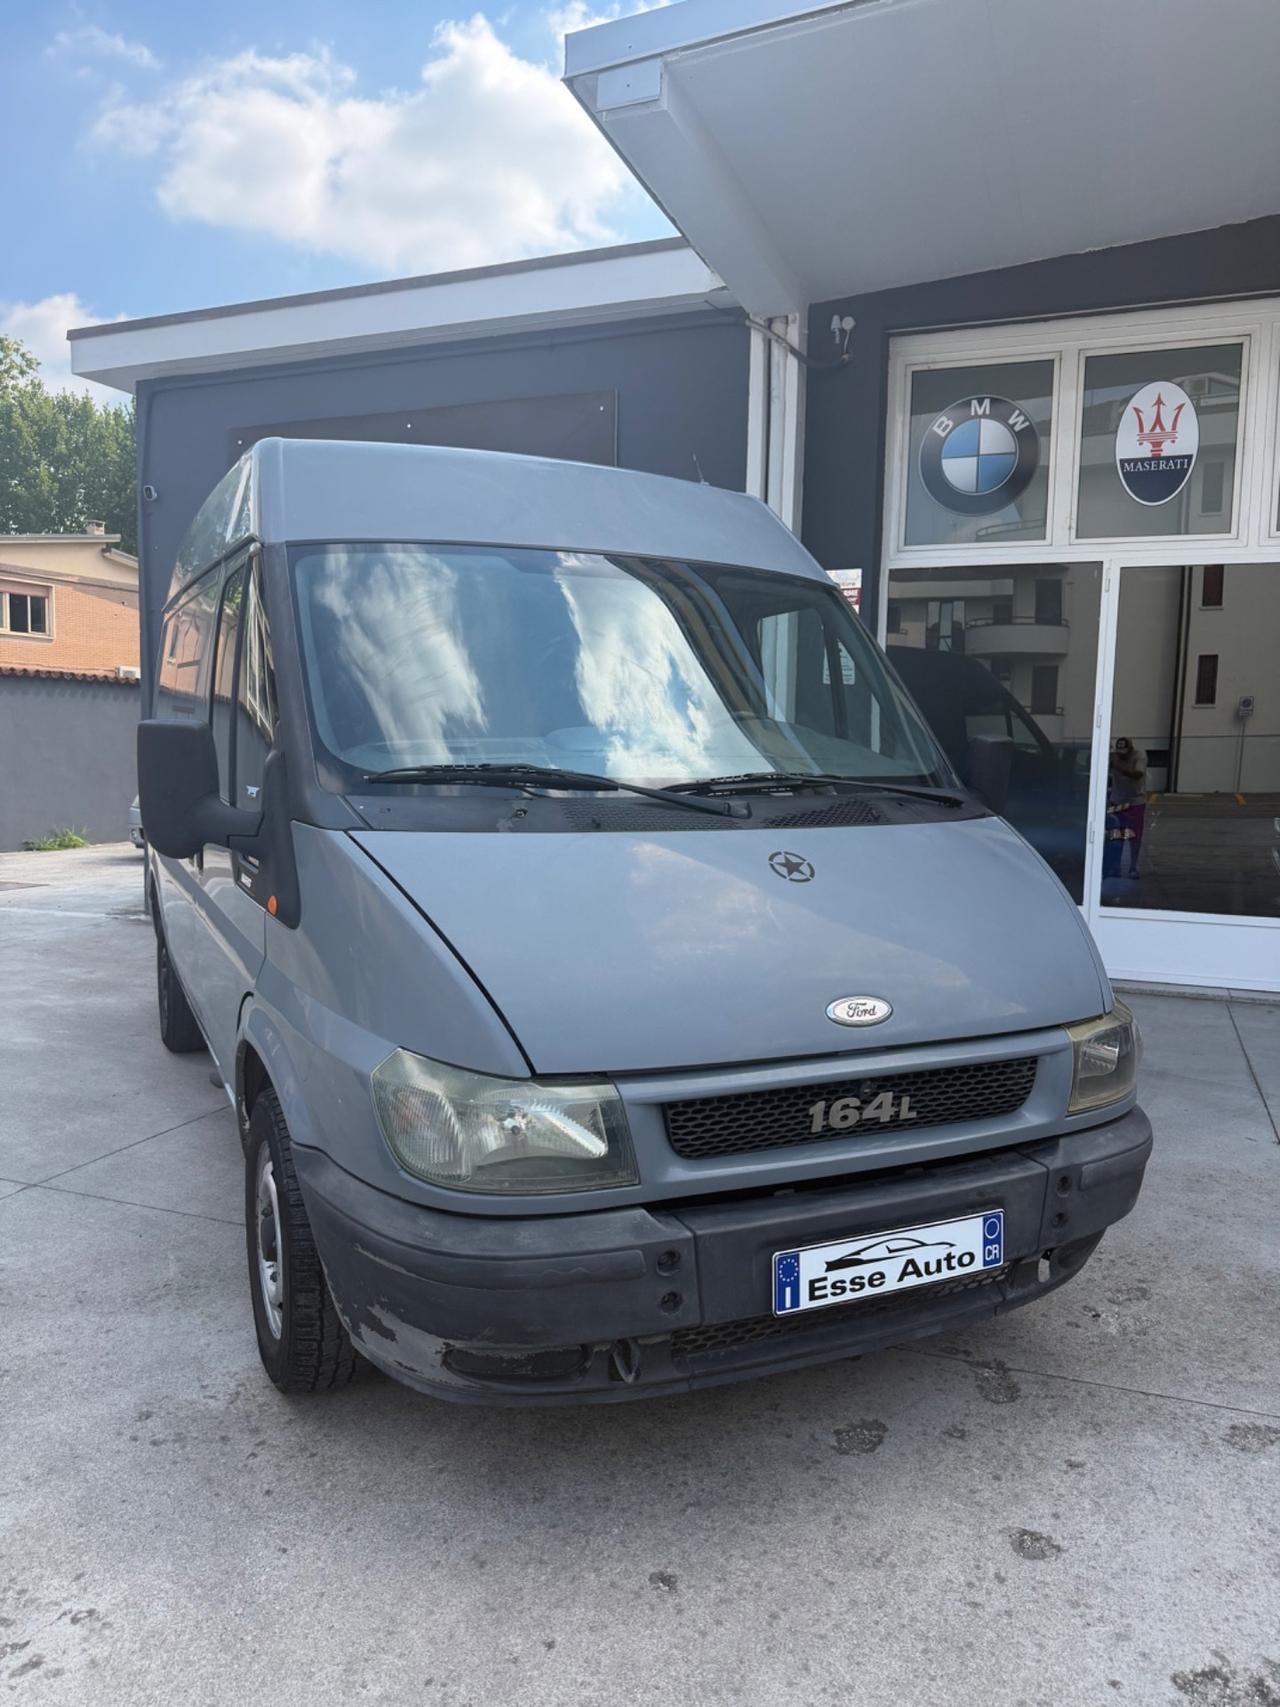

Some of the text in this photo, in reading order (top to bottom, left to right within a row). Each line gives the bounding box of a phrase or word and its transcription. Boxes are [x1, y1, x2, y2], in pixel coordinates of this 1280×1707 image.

[932, 398, 1030, 438] BMW
[1123, 458, 1188, 473] MASERATI
[846, 1002, 877, 1018] Ford
[808, 1091, 917, 1133] 164L
[985, 1244, 1000, 1261] CR
[808, 1250, 976, 1302] Esse Auto
